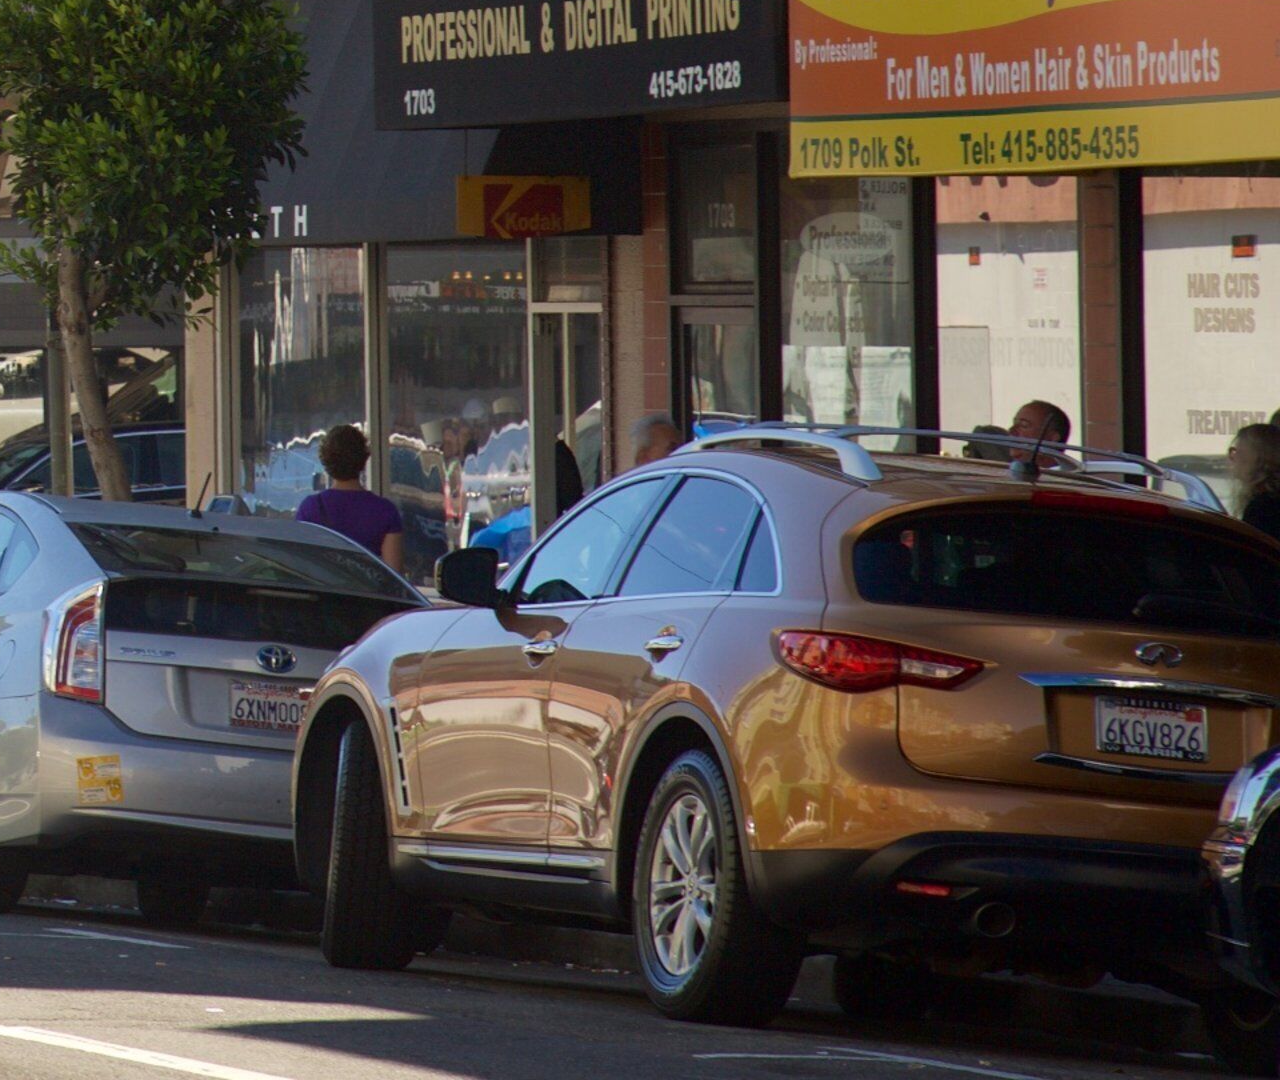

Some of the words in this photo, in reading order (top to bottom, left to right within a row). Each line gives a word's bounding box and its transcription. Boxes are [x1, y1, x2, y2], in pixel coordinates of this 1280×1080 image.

[401, 5, 531, 64] PROFESSIONAL
[541, 2, 554, 54] &
[794, 39, 807, 65] By
[808, 35, 878, 63] Professional:
[648, 60, 742, 99] 415-673-1828
[886, 58, 912, 101] For
[916, 55, 950, 99] Men
[954, 58, 966, 96] &
[969, 50, 1031, 96] Women
[1035, 47, 1071, 92] Hair
[1076, 44, 1088, 89] &
[1093, 42, 1133, 88] Skin
[1137, 36, 1220, 85] Products
[403, 88, 435, 116] 1703
[800, 137, 842, 169] 1709
[848, 136, 887, 169] Polk
[894, 135, 920, 167] St.
[960, 133, 996, 165] Tel:
[1000, 123, 1140, 164] 415-885-4355
[504, 211, 562, 232] Kodak
[1188, 273, 1220, 298] HAIR
[1224, 273, 1260, 298] CUTS
[1194, 307, 1256, 333] DESIGNS
[1105, 717, 1200, 752] 6KGV826
[1124, 745, 1184, 758] MARIN
